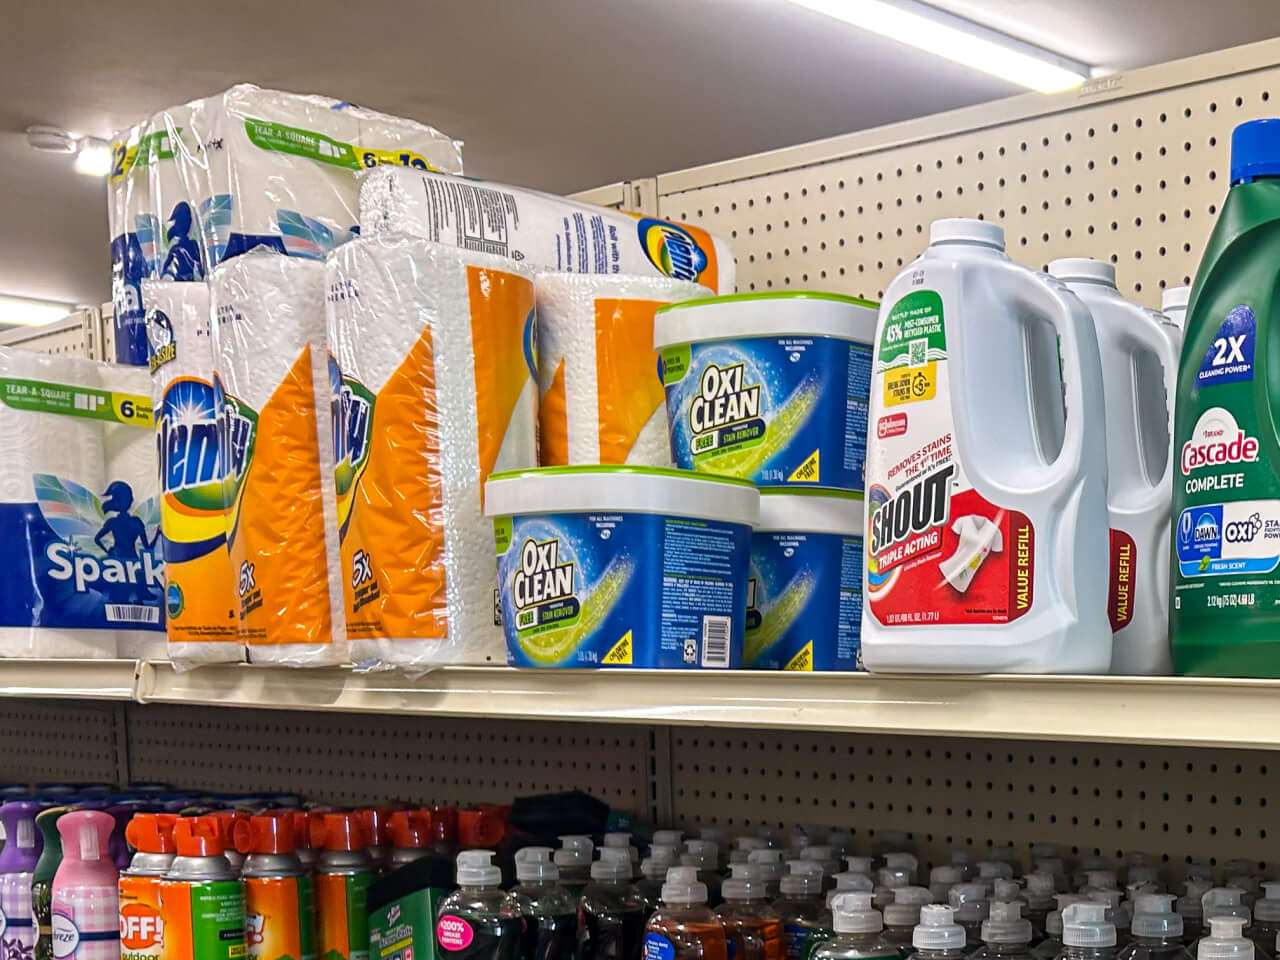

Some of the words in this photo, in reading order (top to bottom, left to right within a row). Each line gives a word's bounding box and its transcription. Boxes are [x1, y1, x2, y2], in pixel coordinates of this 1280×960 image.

[1212, 334, 1247, 366] 2X
[702, 363, 743, 401] OXI
[120, 400, 135, 418] 6
[691, 387, 761, 433] CLEAN
[887, 449, 922, 480] REMOVES
[922, 433, 952, 454] STAINS
[905, 466, 920, 480] THE
[930, 446, 952, 463] TIME
[1182, 431, 1257, 474] Cascade
[1185, 473, 1245, 494] COMPLETE
[871, 465, 954, 554] SHOUT
[879, 546, 904, 569] TRIPLE
[904, 531, 938, 557] ACTING
[1017, 525, 1031, 566] REFILL
[1194, 525, 1219, 542] DAWN
[1225, 521, 1254, 543] OXI
[523, 540, 558, 577] OXI
[1118, 543, 1131, 575] REFILL
[514, 565, 575, 610] CLEAN
[1016, 571, 1030, 610] VALUE
[1115, 577, 1130, 623] VALUE
